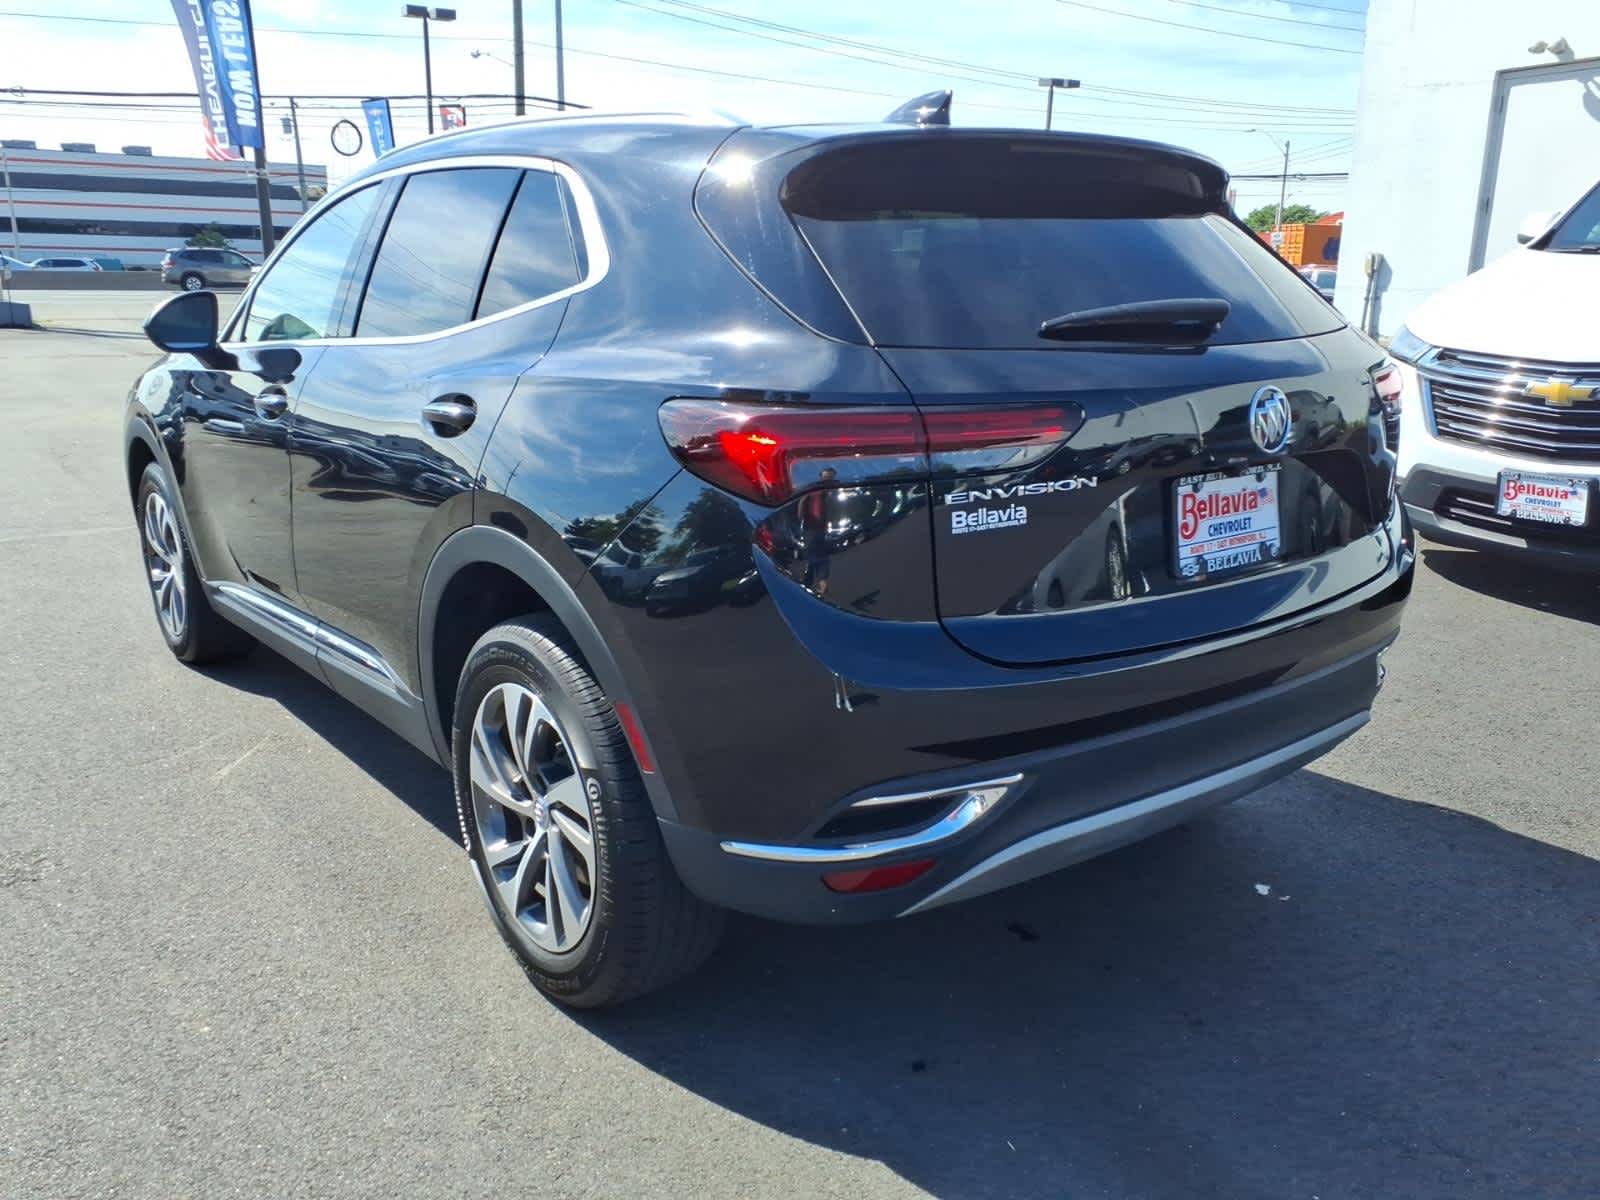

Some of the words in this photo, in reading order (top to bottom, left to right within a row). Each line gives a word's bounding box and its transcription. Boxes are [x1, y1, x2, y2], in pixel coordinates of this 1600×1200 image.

[944, 475, 1098, 505] ENVISION
[1504, 479, 1569, 501] Bellavia
[1525, 497, 1561, 508] CHEVROLET
[952, 503, 1027, 528] Bellavia
[1181, 488, 1258, 540] Bellavia
[1207, 517, 1252, 538] CHEVROLET
[1207, 548, 1262, 573] BELLAVIA
